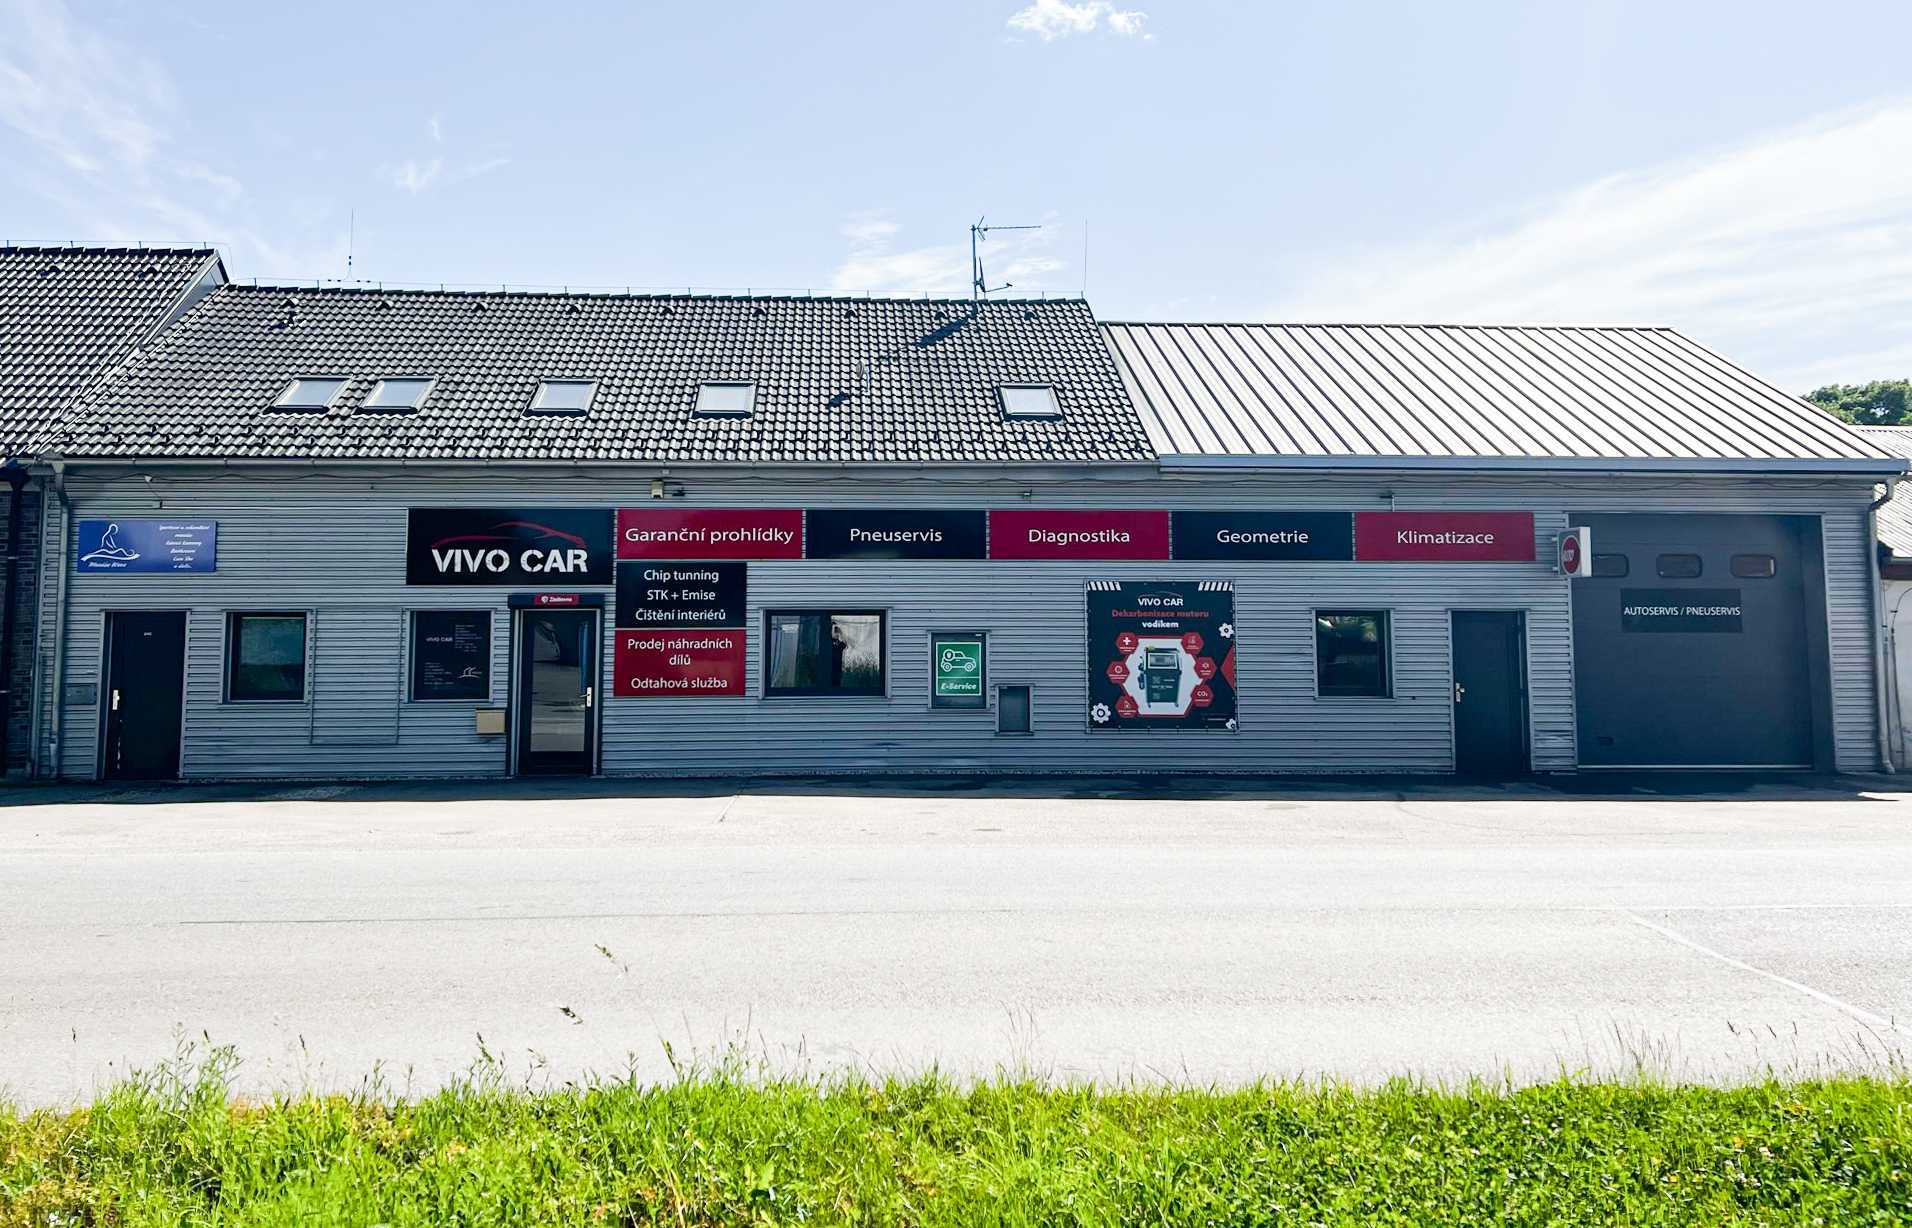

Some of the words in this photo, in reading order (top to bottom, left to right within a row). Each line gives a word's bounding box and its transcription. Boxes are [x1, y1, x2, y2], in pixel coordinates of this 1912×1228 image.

[625, 527, 705, 542] Garanční
[710, 528, 794, 545] prohlídky
[850, 528, 943, 542] Pneuservis
[1028, 528, 1131, 545] Diagnostika
[1216, 529, 1309, 543] Geometrie
[1396, 530, 1494, 545] Klimatizace
[431, 549, 510, 572] VIVO
[520, 549, 588, 572] CAR
[643, 569, 671, 583] Chip
[673, 569, 719, 583] tunning
[646, 589, 669, 600] STK
[671, 591, 679, 600] +
[682, 589, 716, 600] Emise
[1138, 598, 1161, 606] VIVO
[1163, 598, 1184, 606] CAR
[635, 607, 675, 620] Čištění
[677, 608, 726, 620] interiérů
[1623, 606, 1679, 616] AUTOSERVIS
[1686, 606, 1741, 616] PNEUSERVIS
[1141, 620, 1179, 628] vodíkem
[627, 638, 665, 652] Prodej
[667, 638, 733, 650] náhradních
[669, 654, 691, 666] dílů
[631, 678, 688, 689] Odtahová
[691, 677, 728, 689] služba
